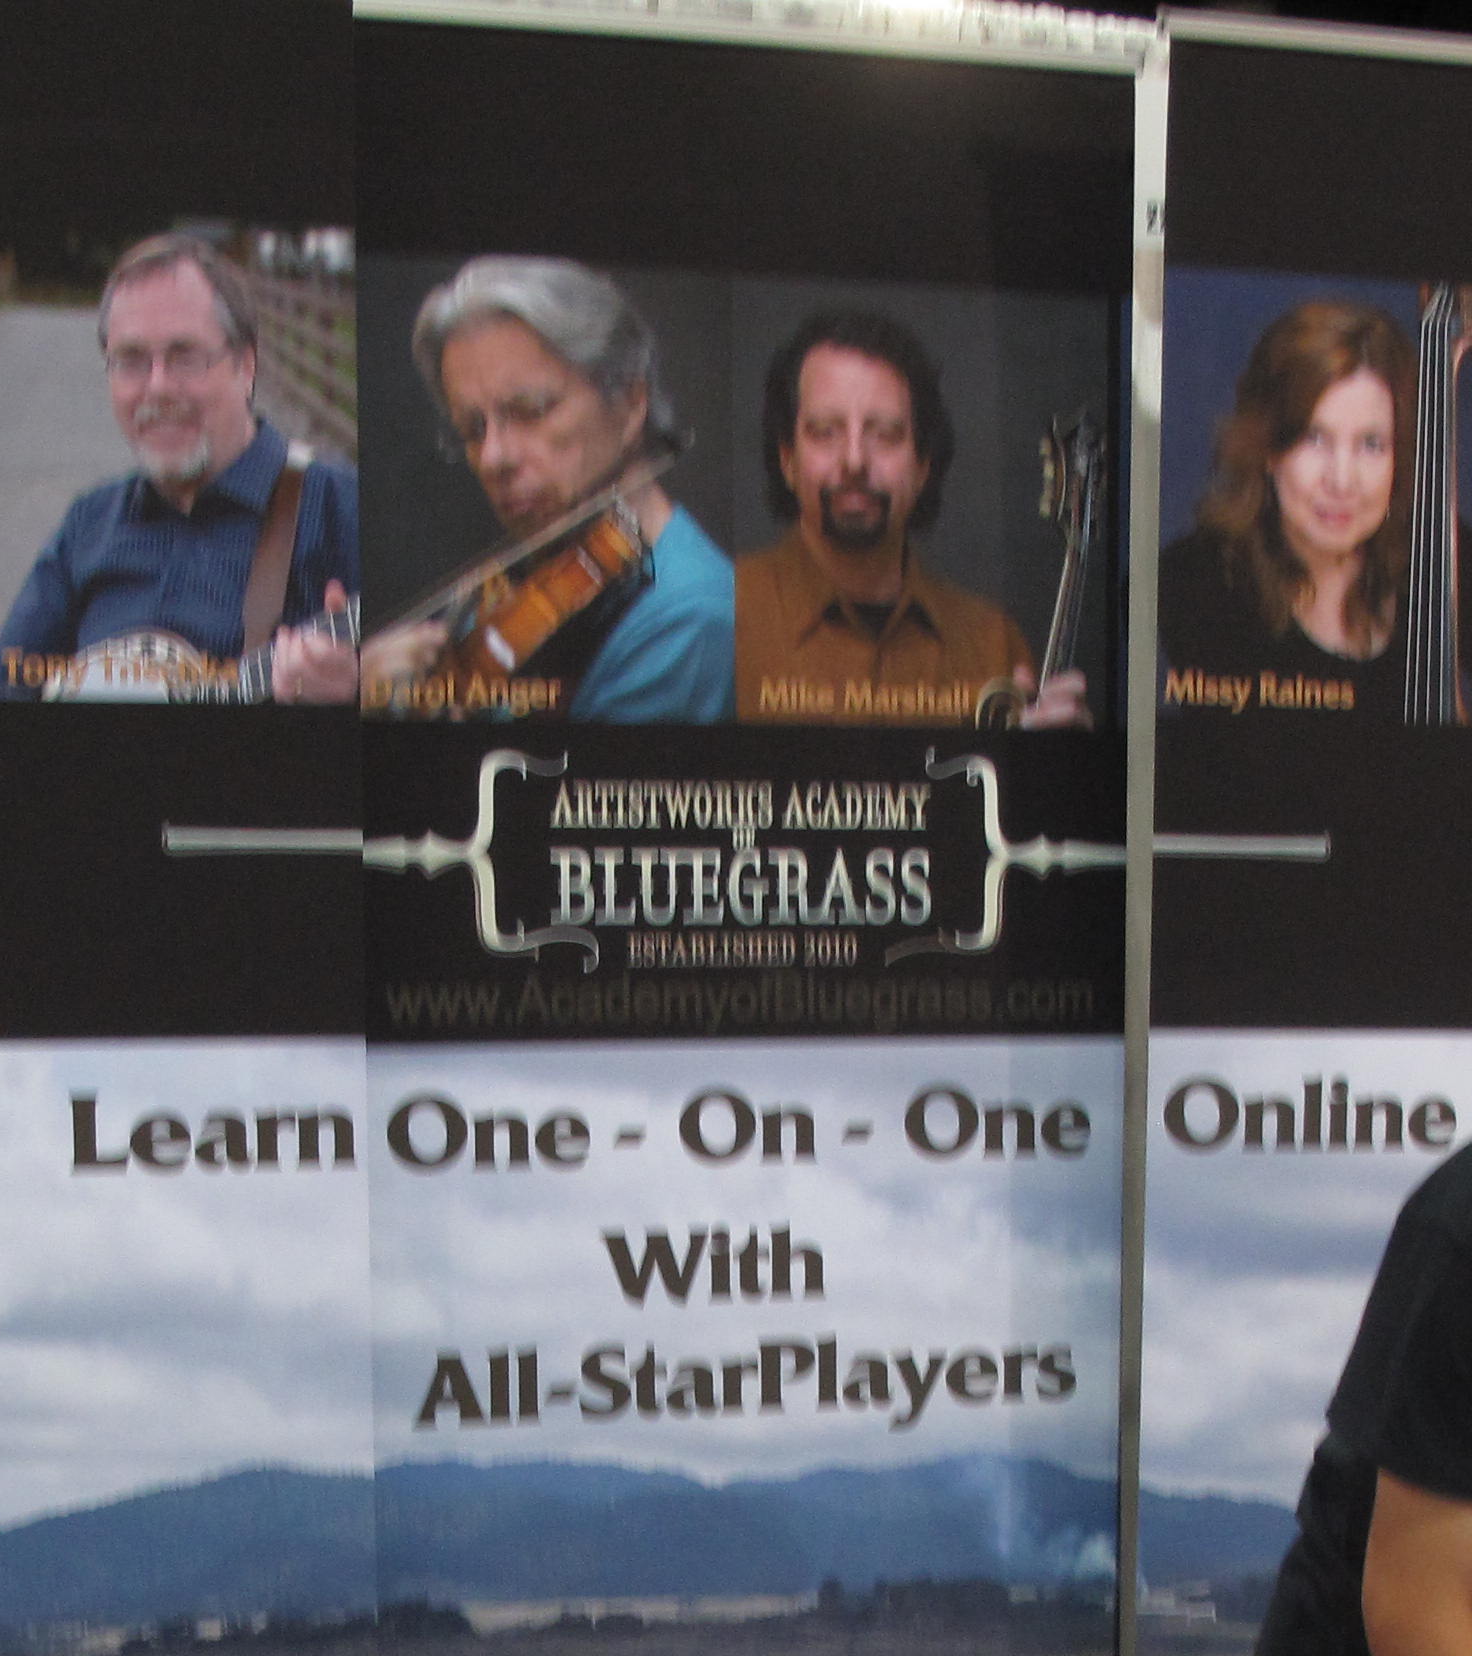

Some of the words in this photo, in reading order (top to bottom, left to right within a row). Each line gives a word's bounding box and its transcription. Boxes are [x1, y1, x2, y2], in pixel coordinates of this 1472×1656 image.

[465, 672, 561, 718] Anger
[759, 678, 834, 714] Mike
[843, 678, 970, 716] Marshall
[1164, 667, 1251, 713] Missy
[1258, 672, 1355, 711] Raines
[549, 778, 774, 830] ARTISTWORKS
[780, 779, 929, 832] ACADEMY
[549, 846, 931, 927] BLUEGRASS
[628, 929, 797, 969] ESTABLISHED
[803, 929, 859, 968] 2010
[69, 1088, 356, 1179] Learn
[384, 1088, 592, 1174] One
[677, 1085, 817, 1164] On
[904, 1079, 1092, 1162] One
[1162, 1074, 1459, 1155] Online
[599, 1219, 826, 1309] With
